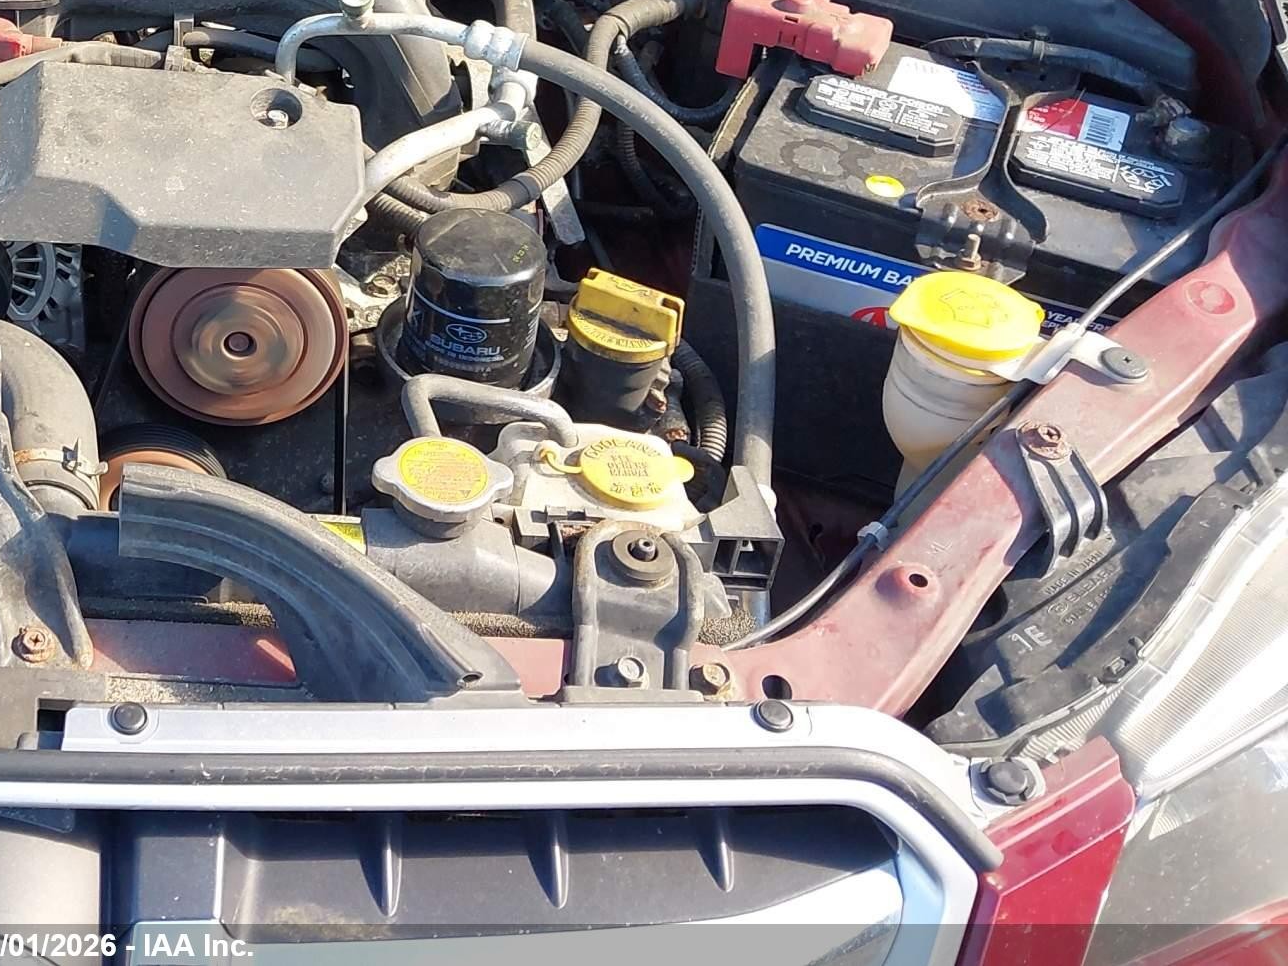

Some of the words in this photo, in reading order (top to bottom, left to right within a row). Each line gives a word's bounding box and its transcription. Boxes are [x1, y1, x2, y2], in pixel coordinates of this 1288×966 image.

[785, 243, 882, 280] PREMIUM
[882, 269, 918, 287] BA
[1047, 311, 1080, 324] YEA
[430, 333, 500, 356] SUBARU
